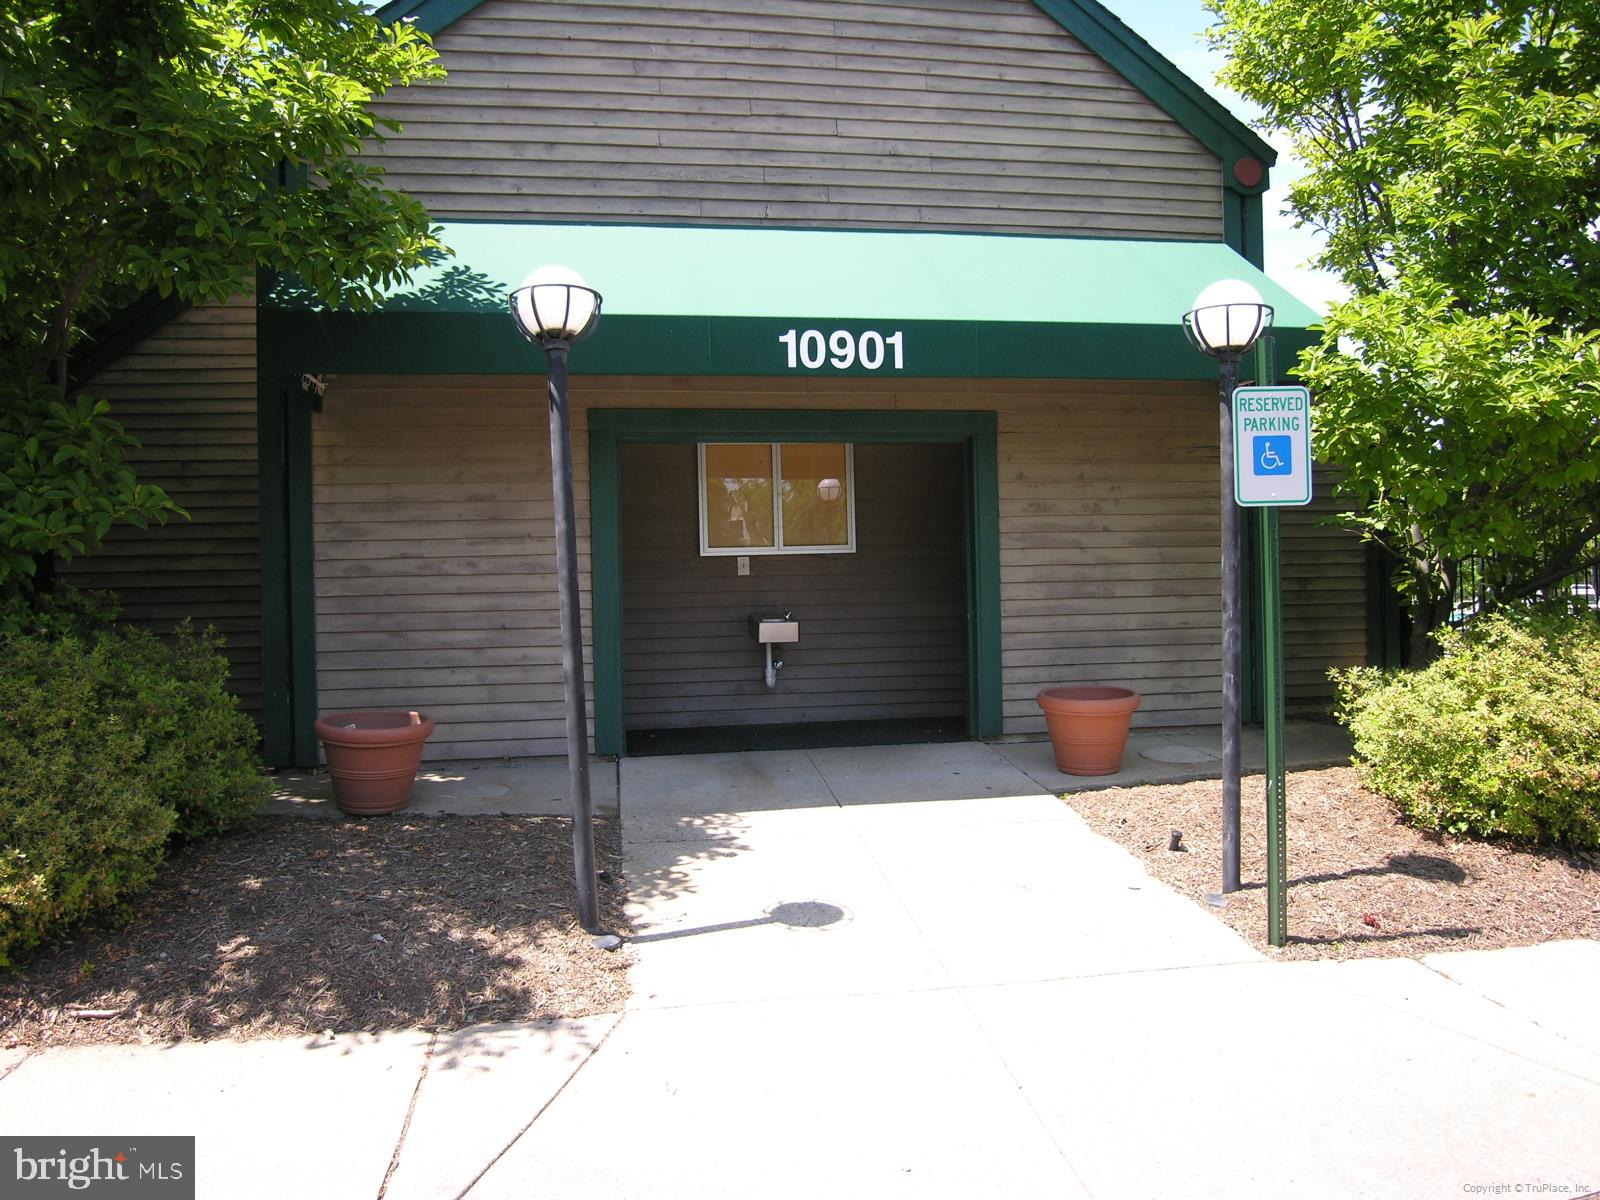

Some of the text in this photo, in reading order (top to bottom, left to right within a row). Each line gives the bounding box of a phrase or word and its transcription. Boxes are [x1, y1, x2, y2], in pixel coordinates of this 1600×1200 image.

[778, 329, 904, 370] 10901
[1239, 397, 1304, 412] RESERVED
[1243, 416, 1300, 432] PARKING
